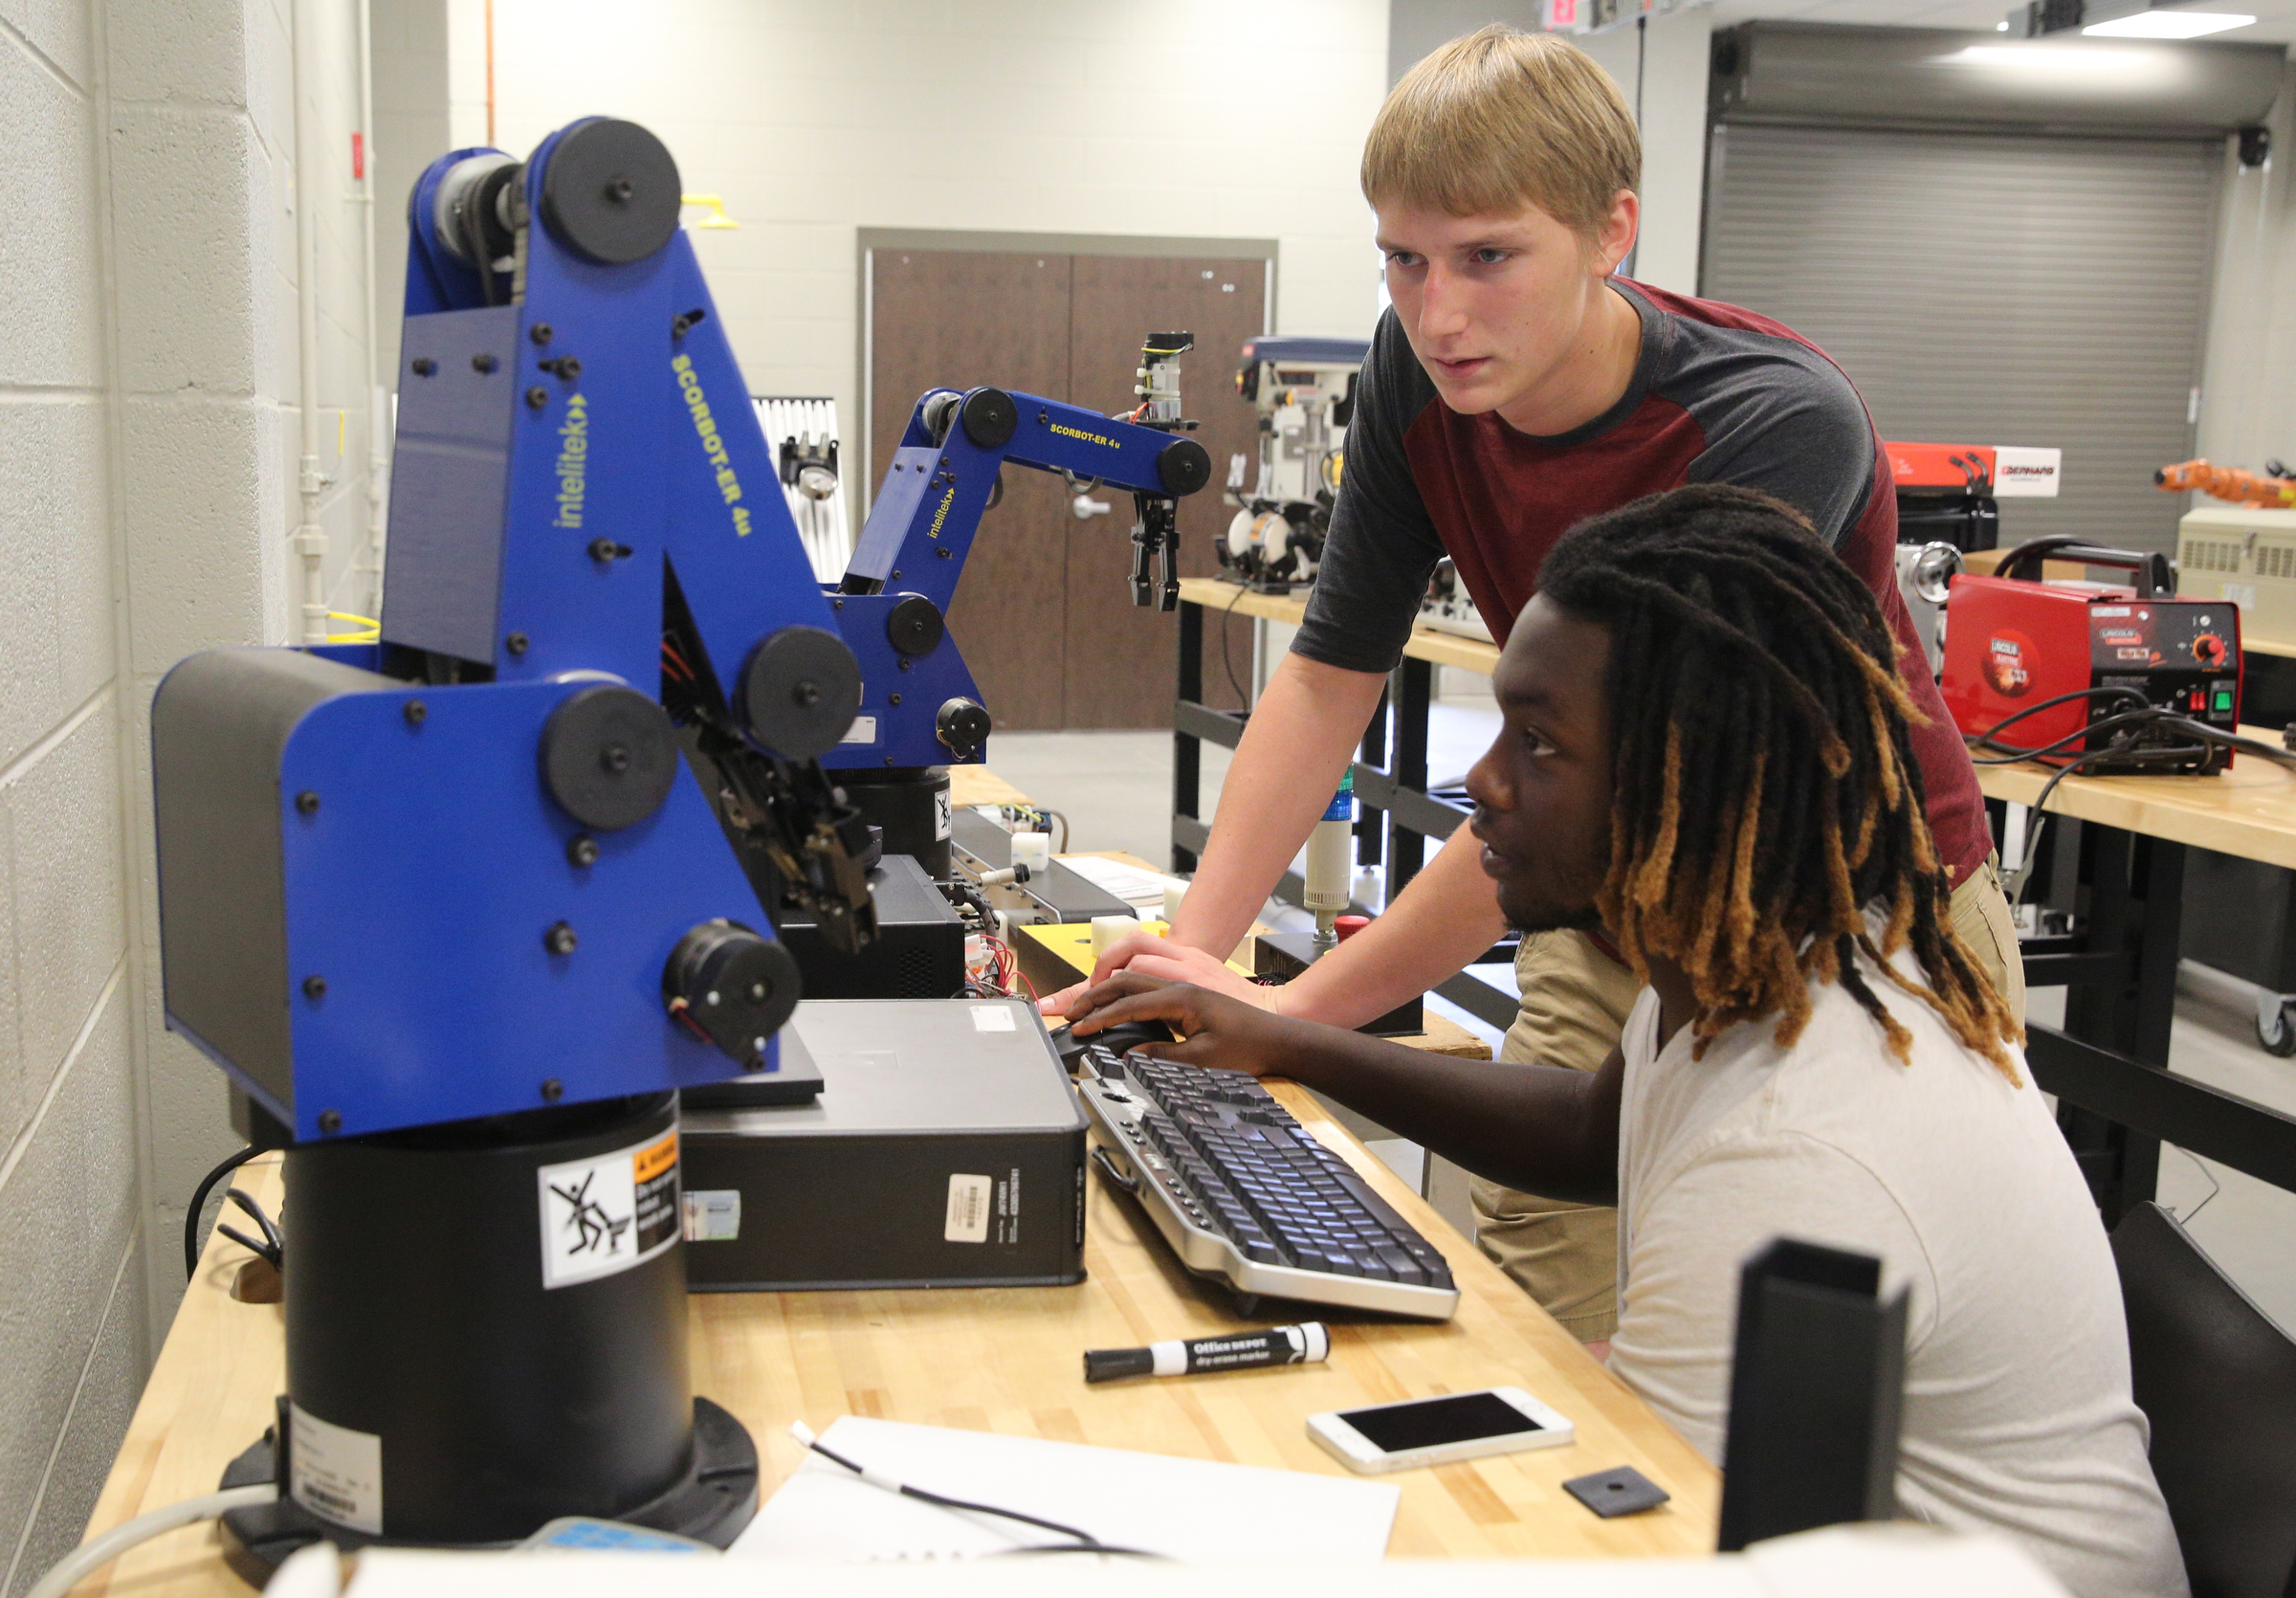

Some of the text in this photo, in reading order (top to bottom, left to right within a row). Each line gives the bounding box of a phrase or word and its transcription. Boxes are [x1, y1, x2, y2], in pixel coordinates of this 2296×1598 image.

[672, 353, 752, 537] SCORBOT-ER 4u
[1049, 423, 1107, 446] SCORBOT-ER
[553, 417, 588, 527] intelitek
[927, 497, 953, 539] intelitek
[1194, 1338, 1269, 1355] Office DEPOT
[1239, 1350, 1270, 1362] marker
